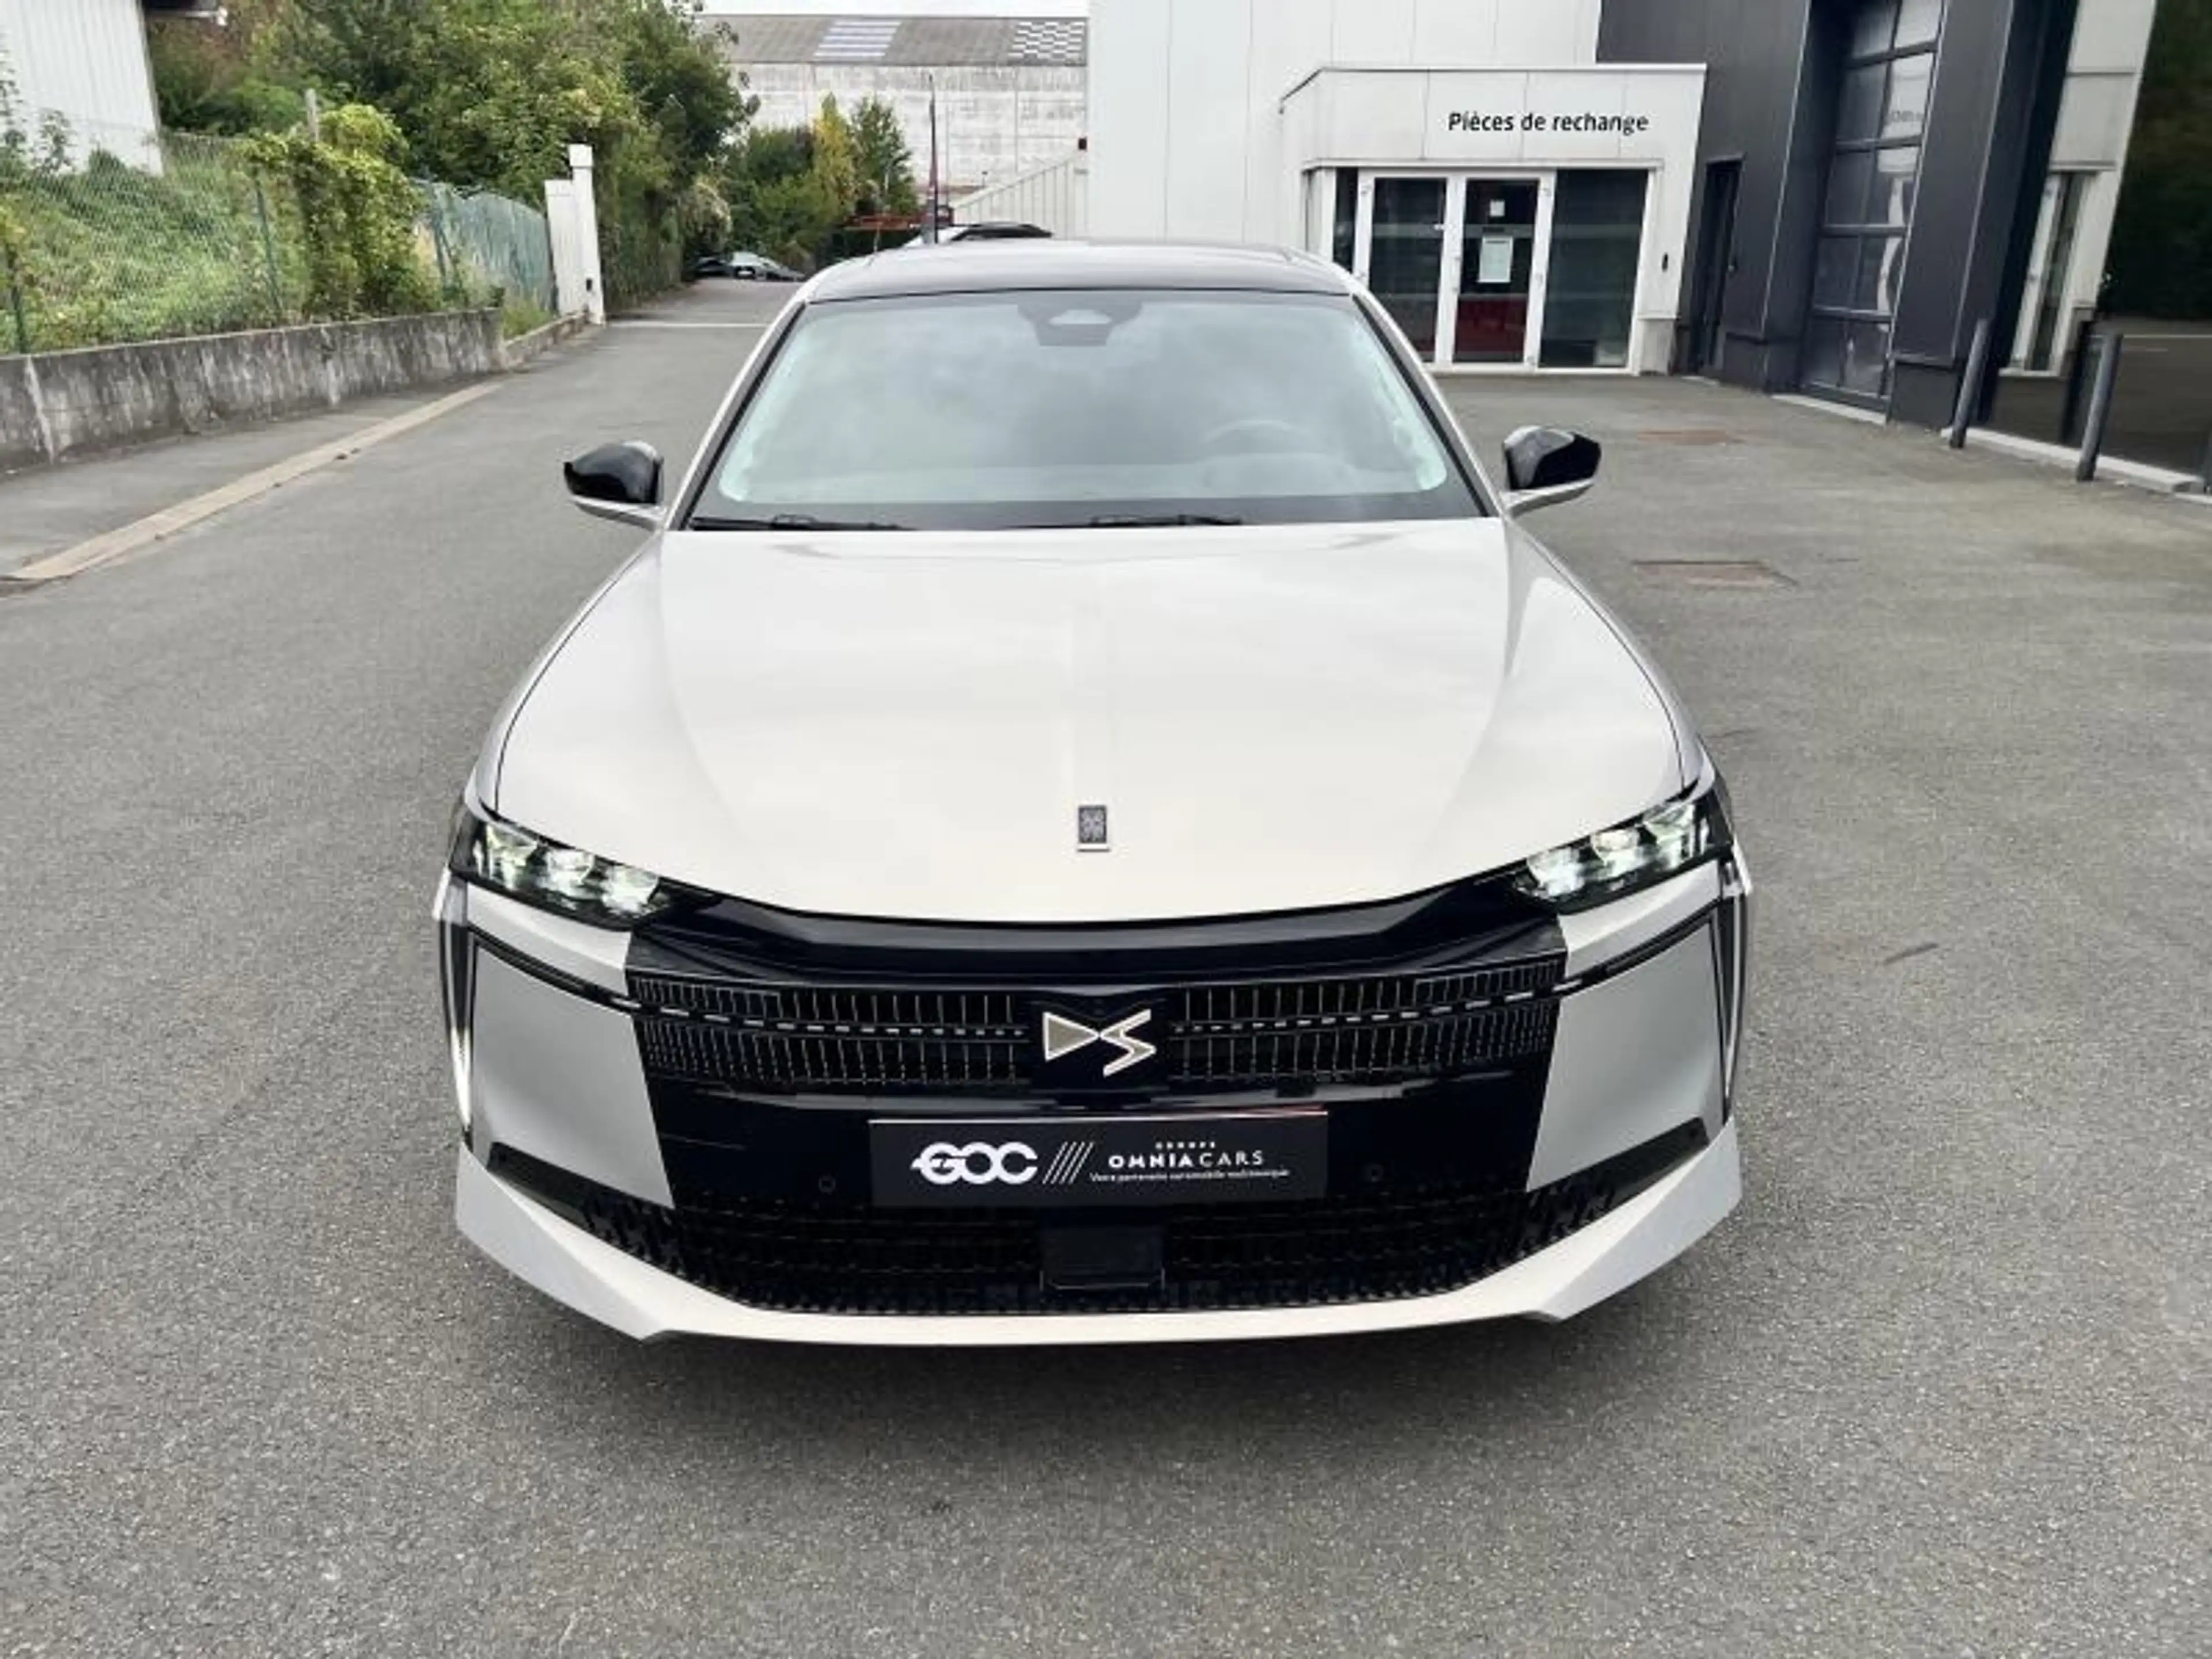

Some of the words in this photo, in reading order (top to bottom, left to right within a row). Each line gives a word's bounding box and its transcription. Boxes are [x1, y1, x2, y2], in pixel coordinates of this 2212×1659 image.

[1448, 111, 1514, 131] Pièces
[1520, 112, 1547, 131] de
[1551, 112, 1649, 137] rechange
[1042, 1008, 1157, 1078] DS
